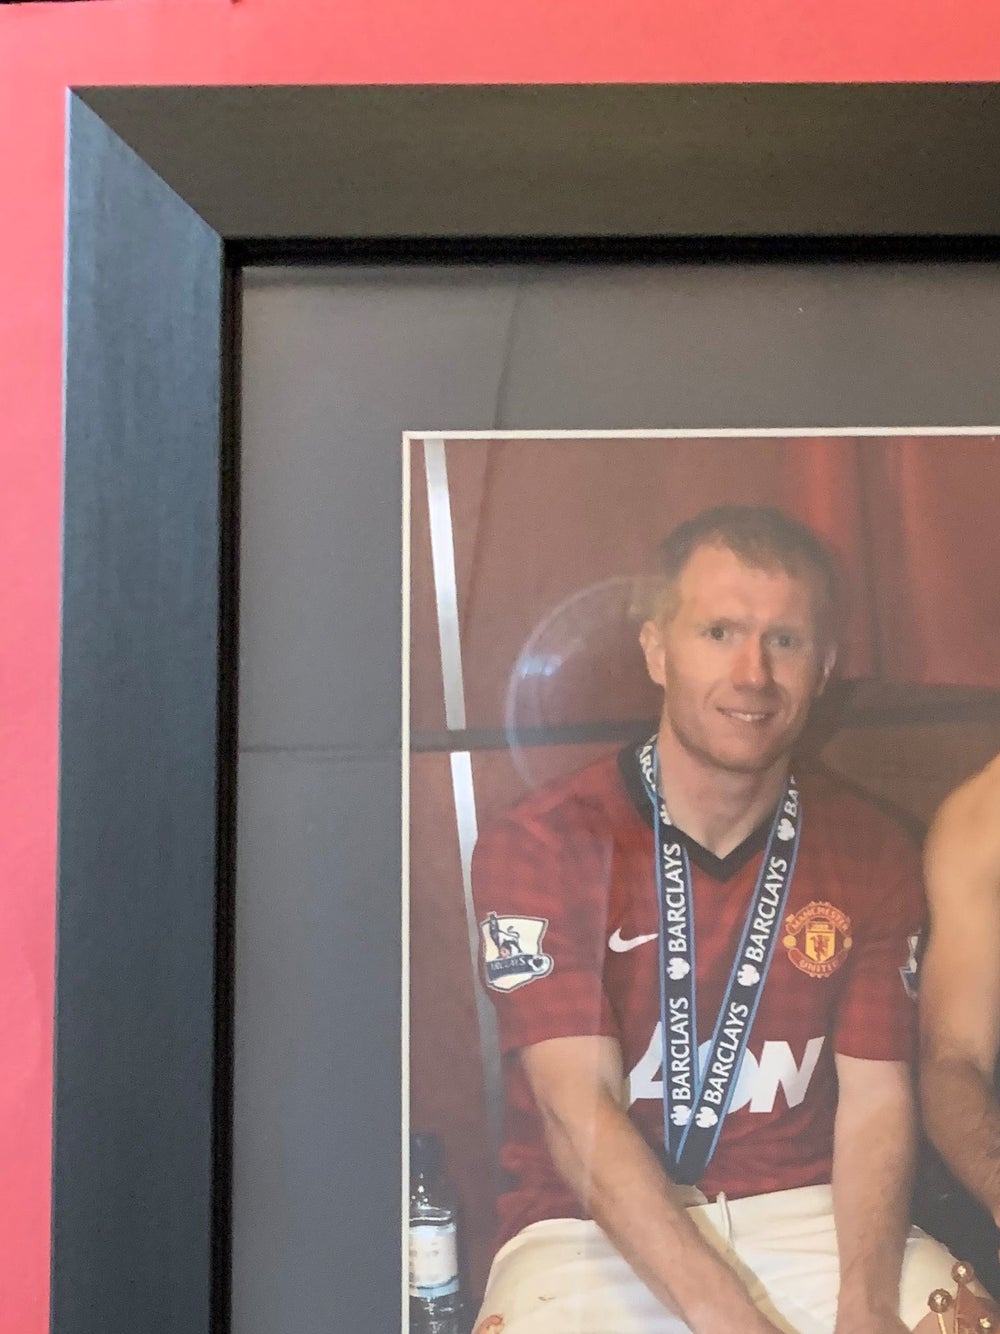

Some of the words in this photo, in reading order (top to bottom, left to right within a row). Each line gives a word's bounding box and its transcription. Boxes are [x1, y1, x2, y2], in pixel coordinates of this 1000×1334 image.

[665, 842, 688, 953] BARCLAYS
[745, 855, 788, 964] BARCLAYS
[671, 996, 691, 1101] BARCLAYS
[703, 1001, 749, 1105] BARCLAYS
